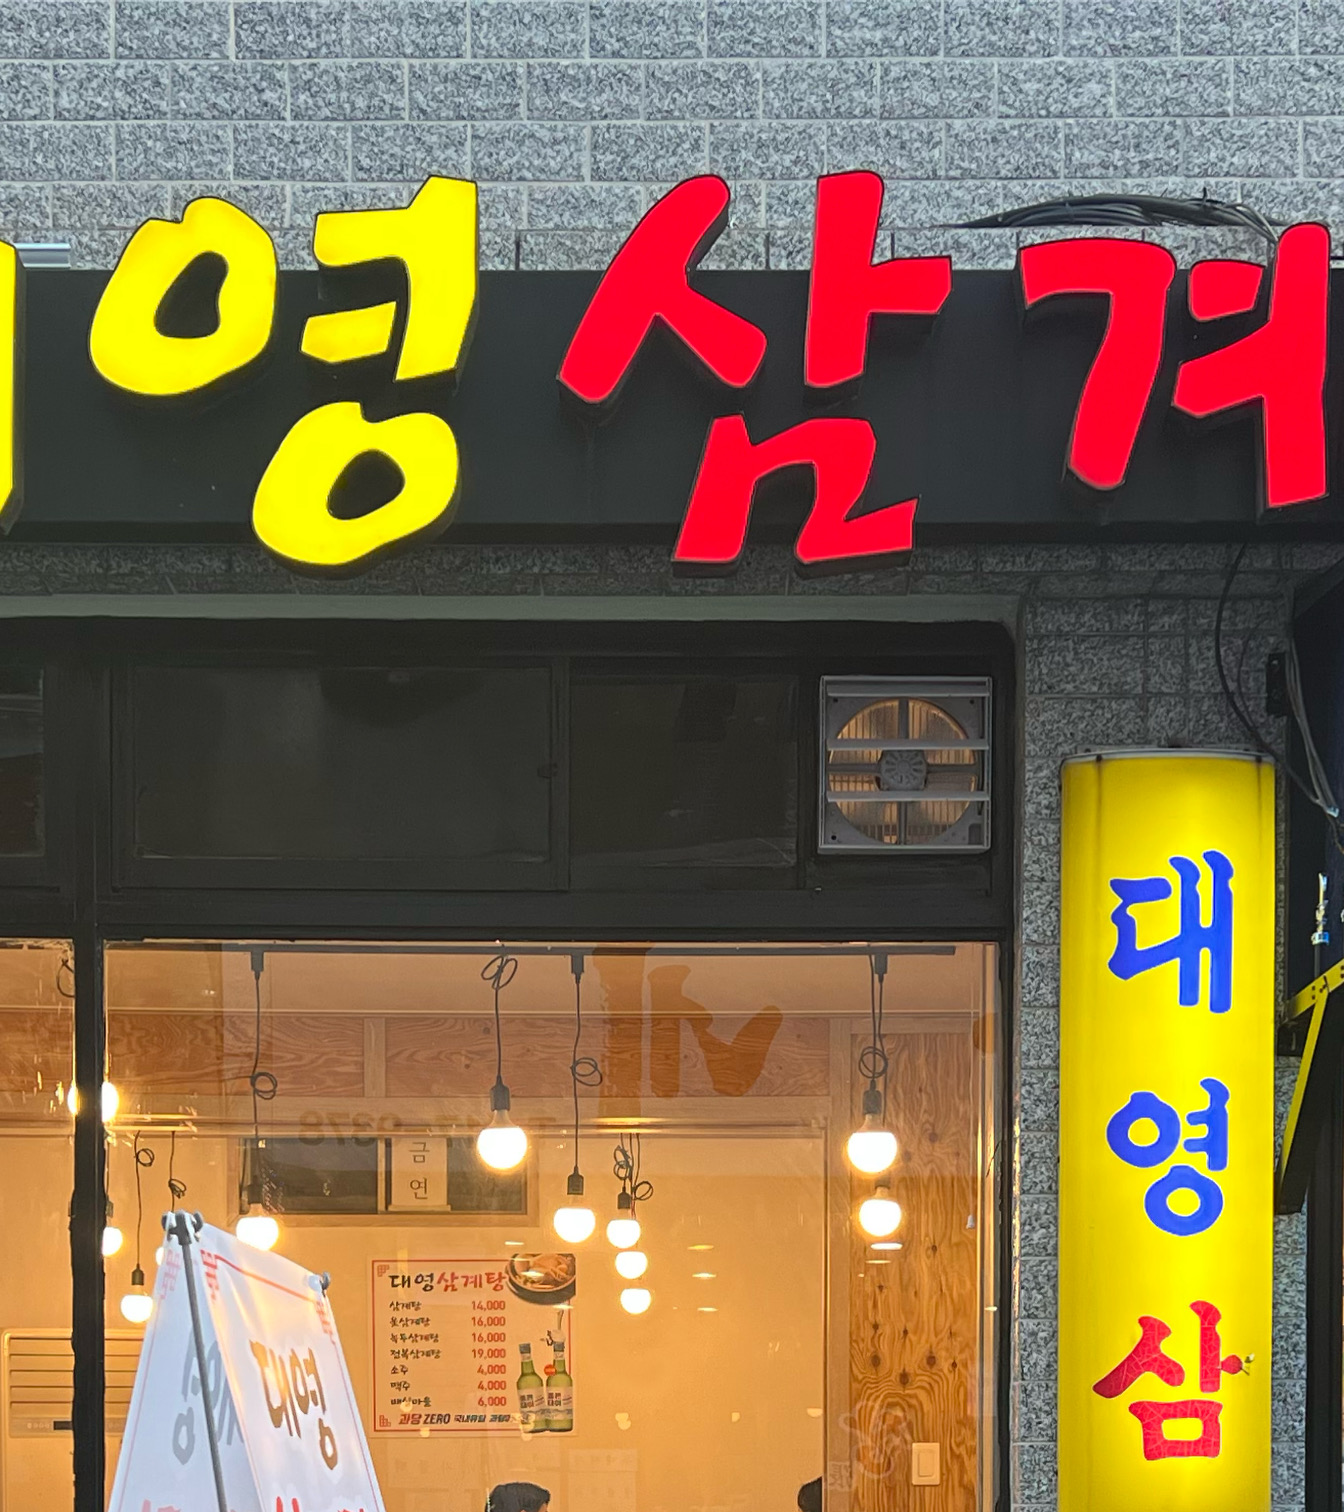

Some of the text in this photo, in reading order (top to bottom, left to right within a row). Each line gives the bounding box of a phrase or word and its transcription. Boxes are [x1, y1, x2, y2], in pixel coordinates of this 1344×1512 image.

[408, 1141, 430, 1200] 금연
[389, 1300, 506, 1312] 삼계탕 14,000
[471, 1316, 506, 1328] 16,000
[471, 1332, 506, 1344] 16,000
[471, 1348, 506, 1360] 19,000
[390, 1364, 506, 1375] 소주 4,000
[390, 1380, 506, 1392] 맥주 4,000
[249, 1339, 338, 1470] 대영
[477, 1396, 507, 1407] 6,000
[423, 1413, 451, 1425] ZERO
